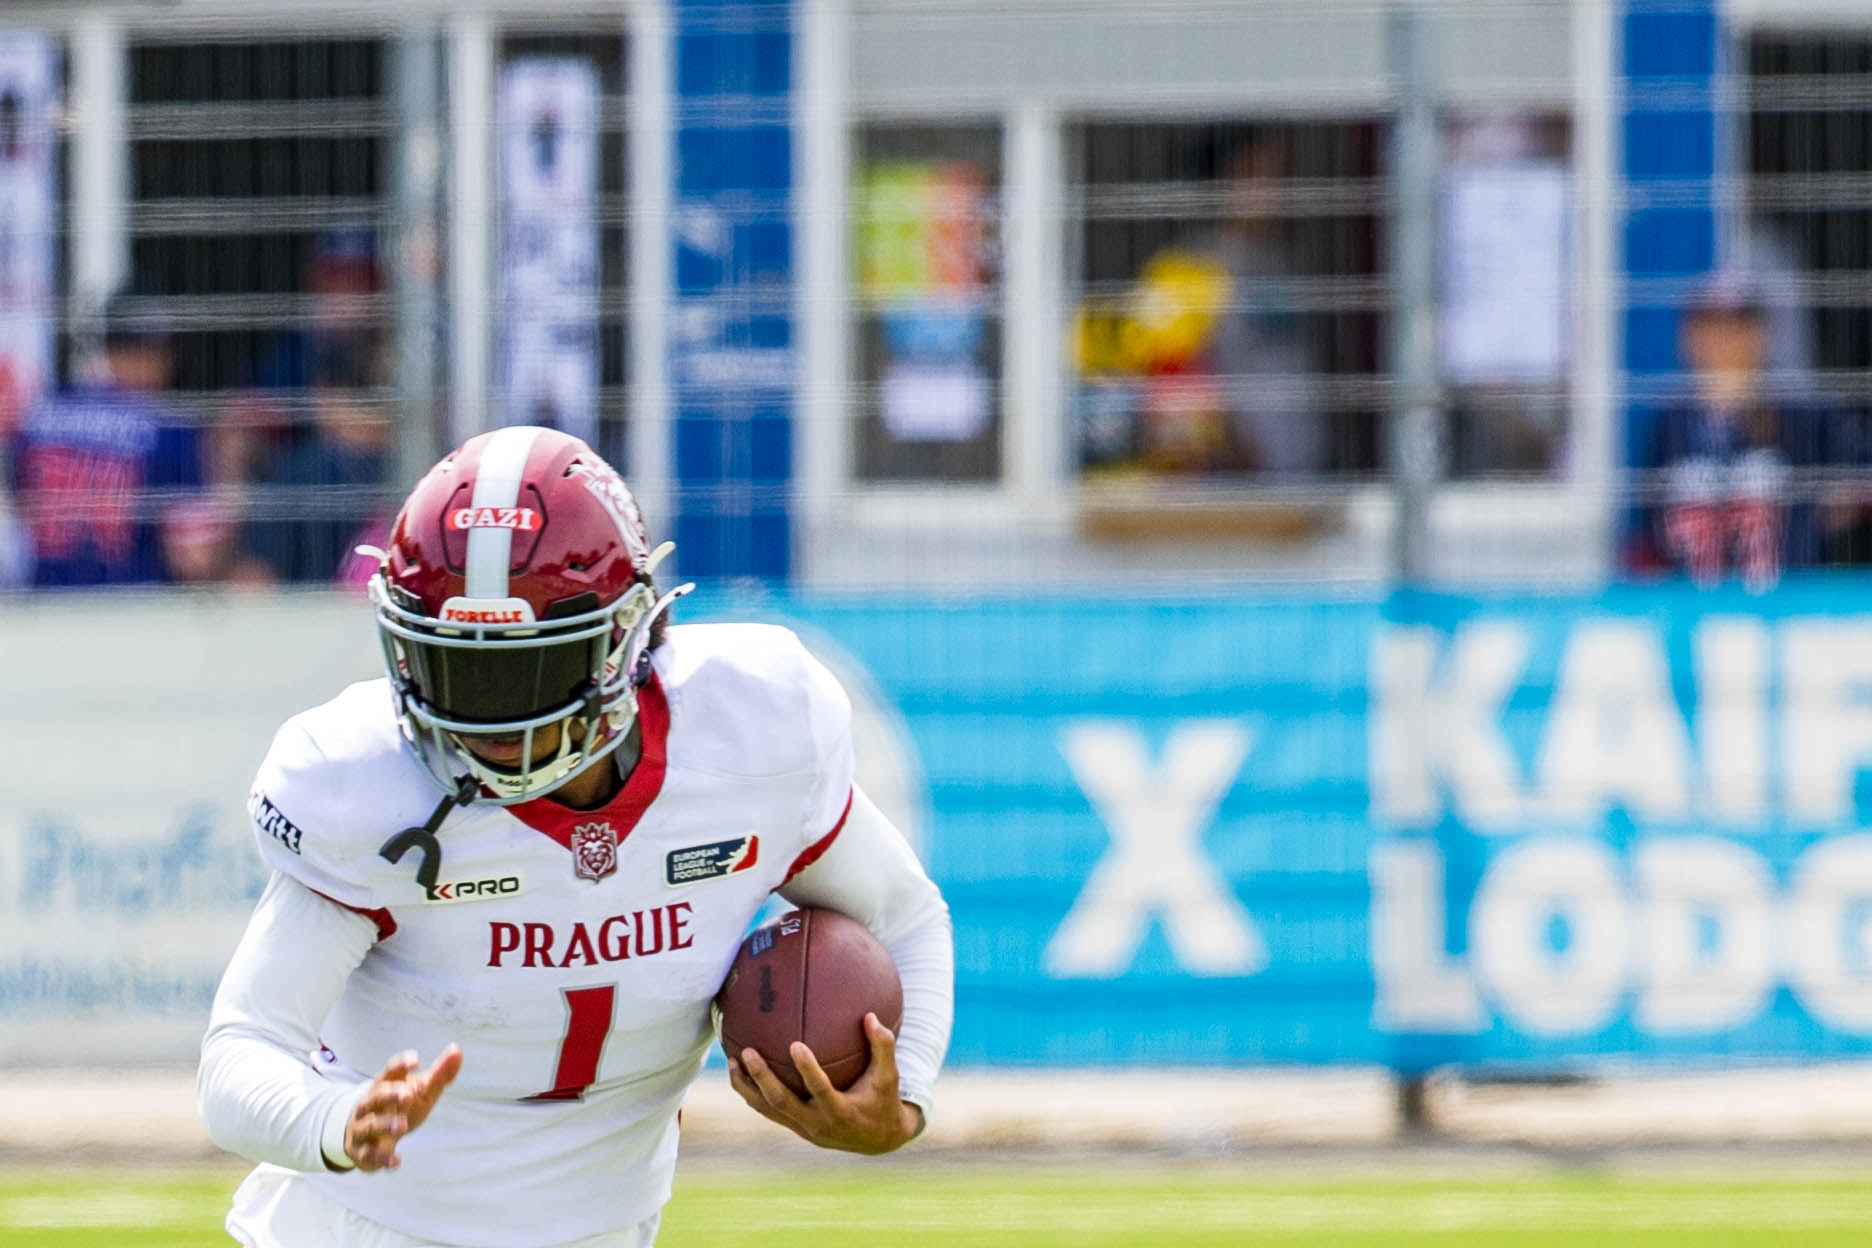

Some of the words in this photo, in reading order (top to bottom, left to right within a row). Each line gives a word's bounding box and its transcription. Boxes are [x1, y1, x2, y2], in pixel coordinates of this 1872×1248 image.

[453, 507, 534, 530] GAZI
[445, 609, 523, 623] FORELLE
[487, 901, 694, 968] PRAGUE
[516, 981, 619, 1104] 1
